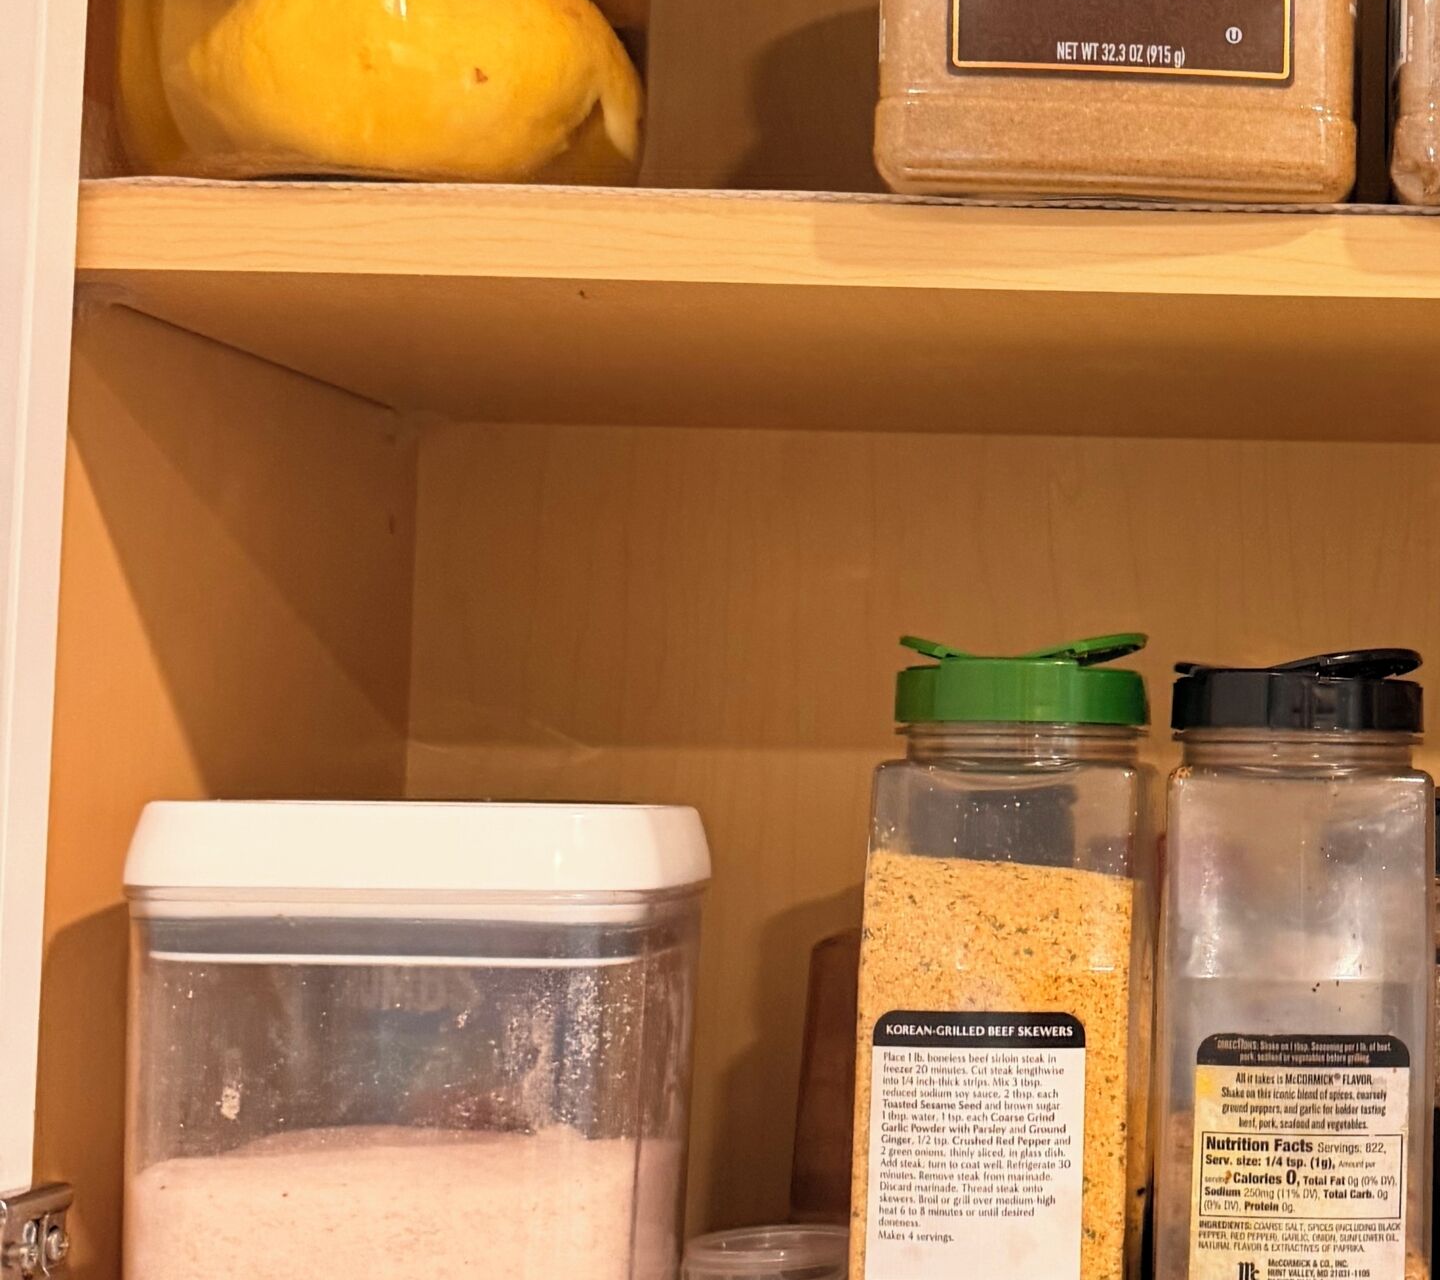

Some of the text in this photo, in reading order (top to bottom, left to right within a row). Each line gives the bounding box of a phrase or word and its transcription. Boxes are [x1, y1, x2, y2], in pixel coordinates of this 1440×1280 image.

[1057, 42, 1186, 68] NET WT 32.3 OZ (915 g)
[886, 1024, 1073, 1036] KOREAN-GRILLED BEEF SKEWERS
[884, 1052, 1056, 1063] Place 1 lb. boneless beef sirloin steak in
[883, 1065, 1064, 1077] freezer 20 minutes. Cut steak lengthwise
[883, 1077, 1041, 1089] into 1/4 inch-thick strips. Mix 3 tbsp.
[1236, 1072, 1245, 1083] All
[1248, 1074, 1253, 1084] it
[1255, 1074, 1274, 1084] takes
[1277, 1075, 1283, 1084] is
[883, 1088, 1058, 1100] reduced sodium soy sauce, 2 tbsp. each
[1207, 1137, 1269, 1151] Nutrition
[1274, 1139, 1313, 1153] Facts
[1206, 1155, 1232, 1165] Serv.
[1237, 1155, 1261, 1166] size:
[1266, 1156, 1283, 1166] 1/4
[1286, 1157, 1306, 1169] tsp.
[1233, 1172, 1282, 1185] Calories
[1286, 1170, 1300, 1187] 0,
[1303, 1176, 1327, 1185] Total
[1330, 1176, 1345, 1186] Fat
[1348, 1176, 1358, 1187] 0g
[1361, 1176, 1378, 1186] (0%
[1205, 1187, 1241, 1197] Sodium
[1244, 1189, 1274, 1199] 250mg
[1277, 1189, 1300, 1199] (11%
[1324, 1189, 1347, 1199] Total
[1350, 1189, 1374, 1199] Carb.
[1377, 1190, 1388, 1200] 0g
[1204, 1200, 1221, 1211] (0%
[1244, 1201, 1278, 1211] Protein
[1282, 1202, 1295, 1213] 0g.
[878, 1232, 954, 1243] Makes 4 servings.
